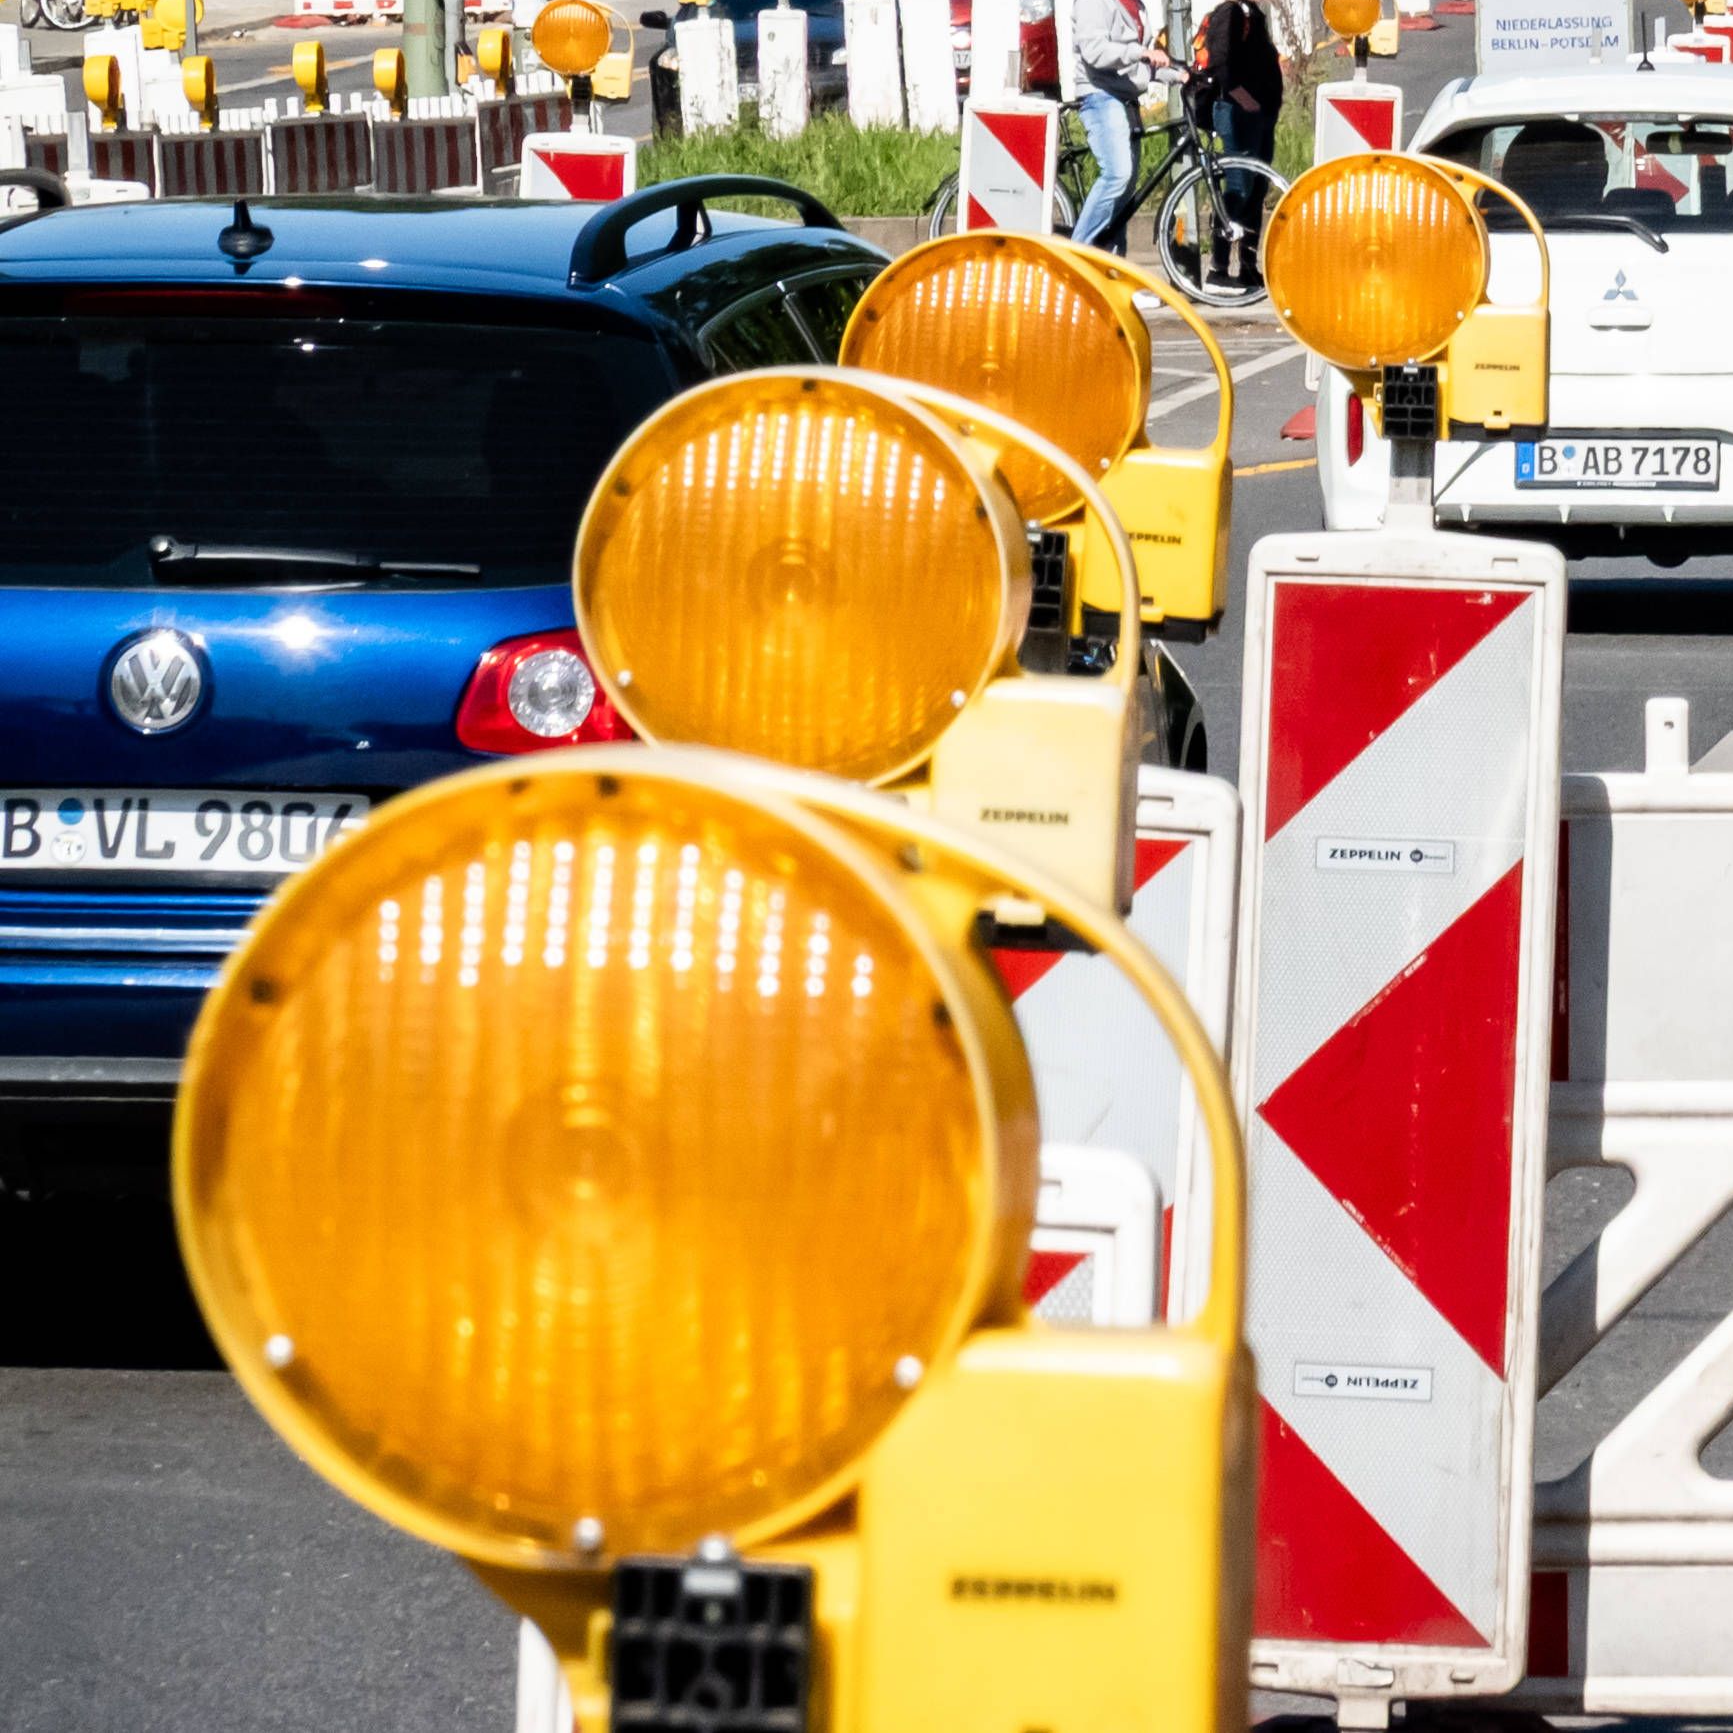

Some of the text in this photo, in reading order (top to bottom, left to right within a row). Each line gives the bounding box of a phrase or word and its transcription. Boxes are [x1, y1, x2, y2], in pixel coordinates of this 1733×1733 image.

[1495, 16, 1613, 31] NIEDERLASSUNG
[1538, 445, 1712, 476] B AB 7178
[1128, 531, 1182, 546] EPPELIN
[981, 808, 1070, 826] ZEPPELIN
[1, 797, 42, 859] B
[92, 797, 176, 860] VL
[1328, 848, 1402, 861] ZEPPELIN
